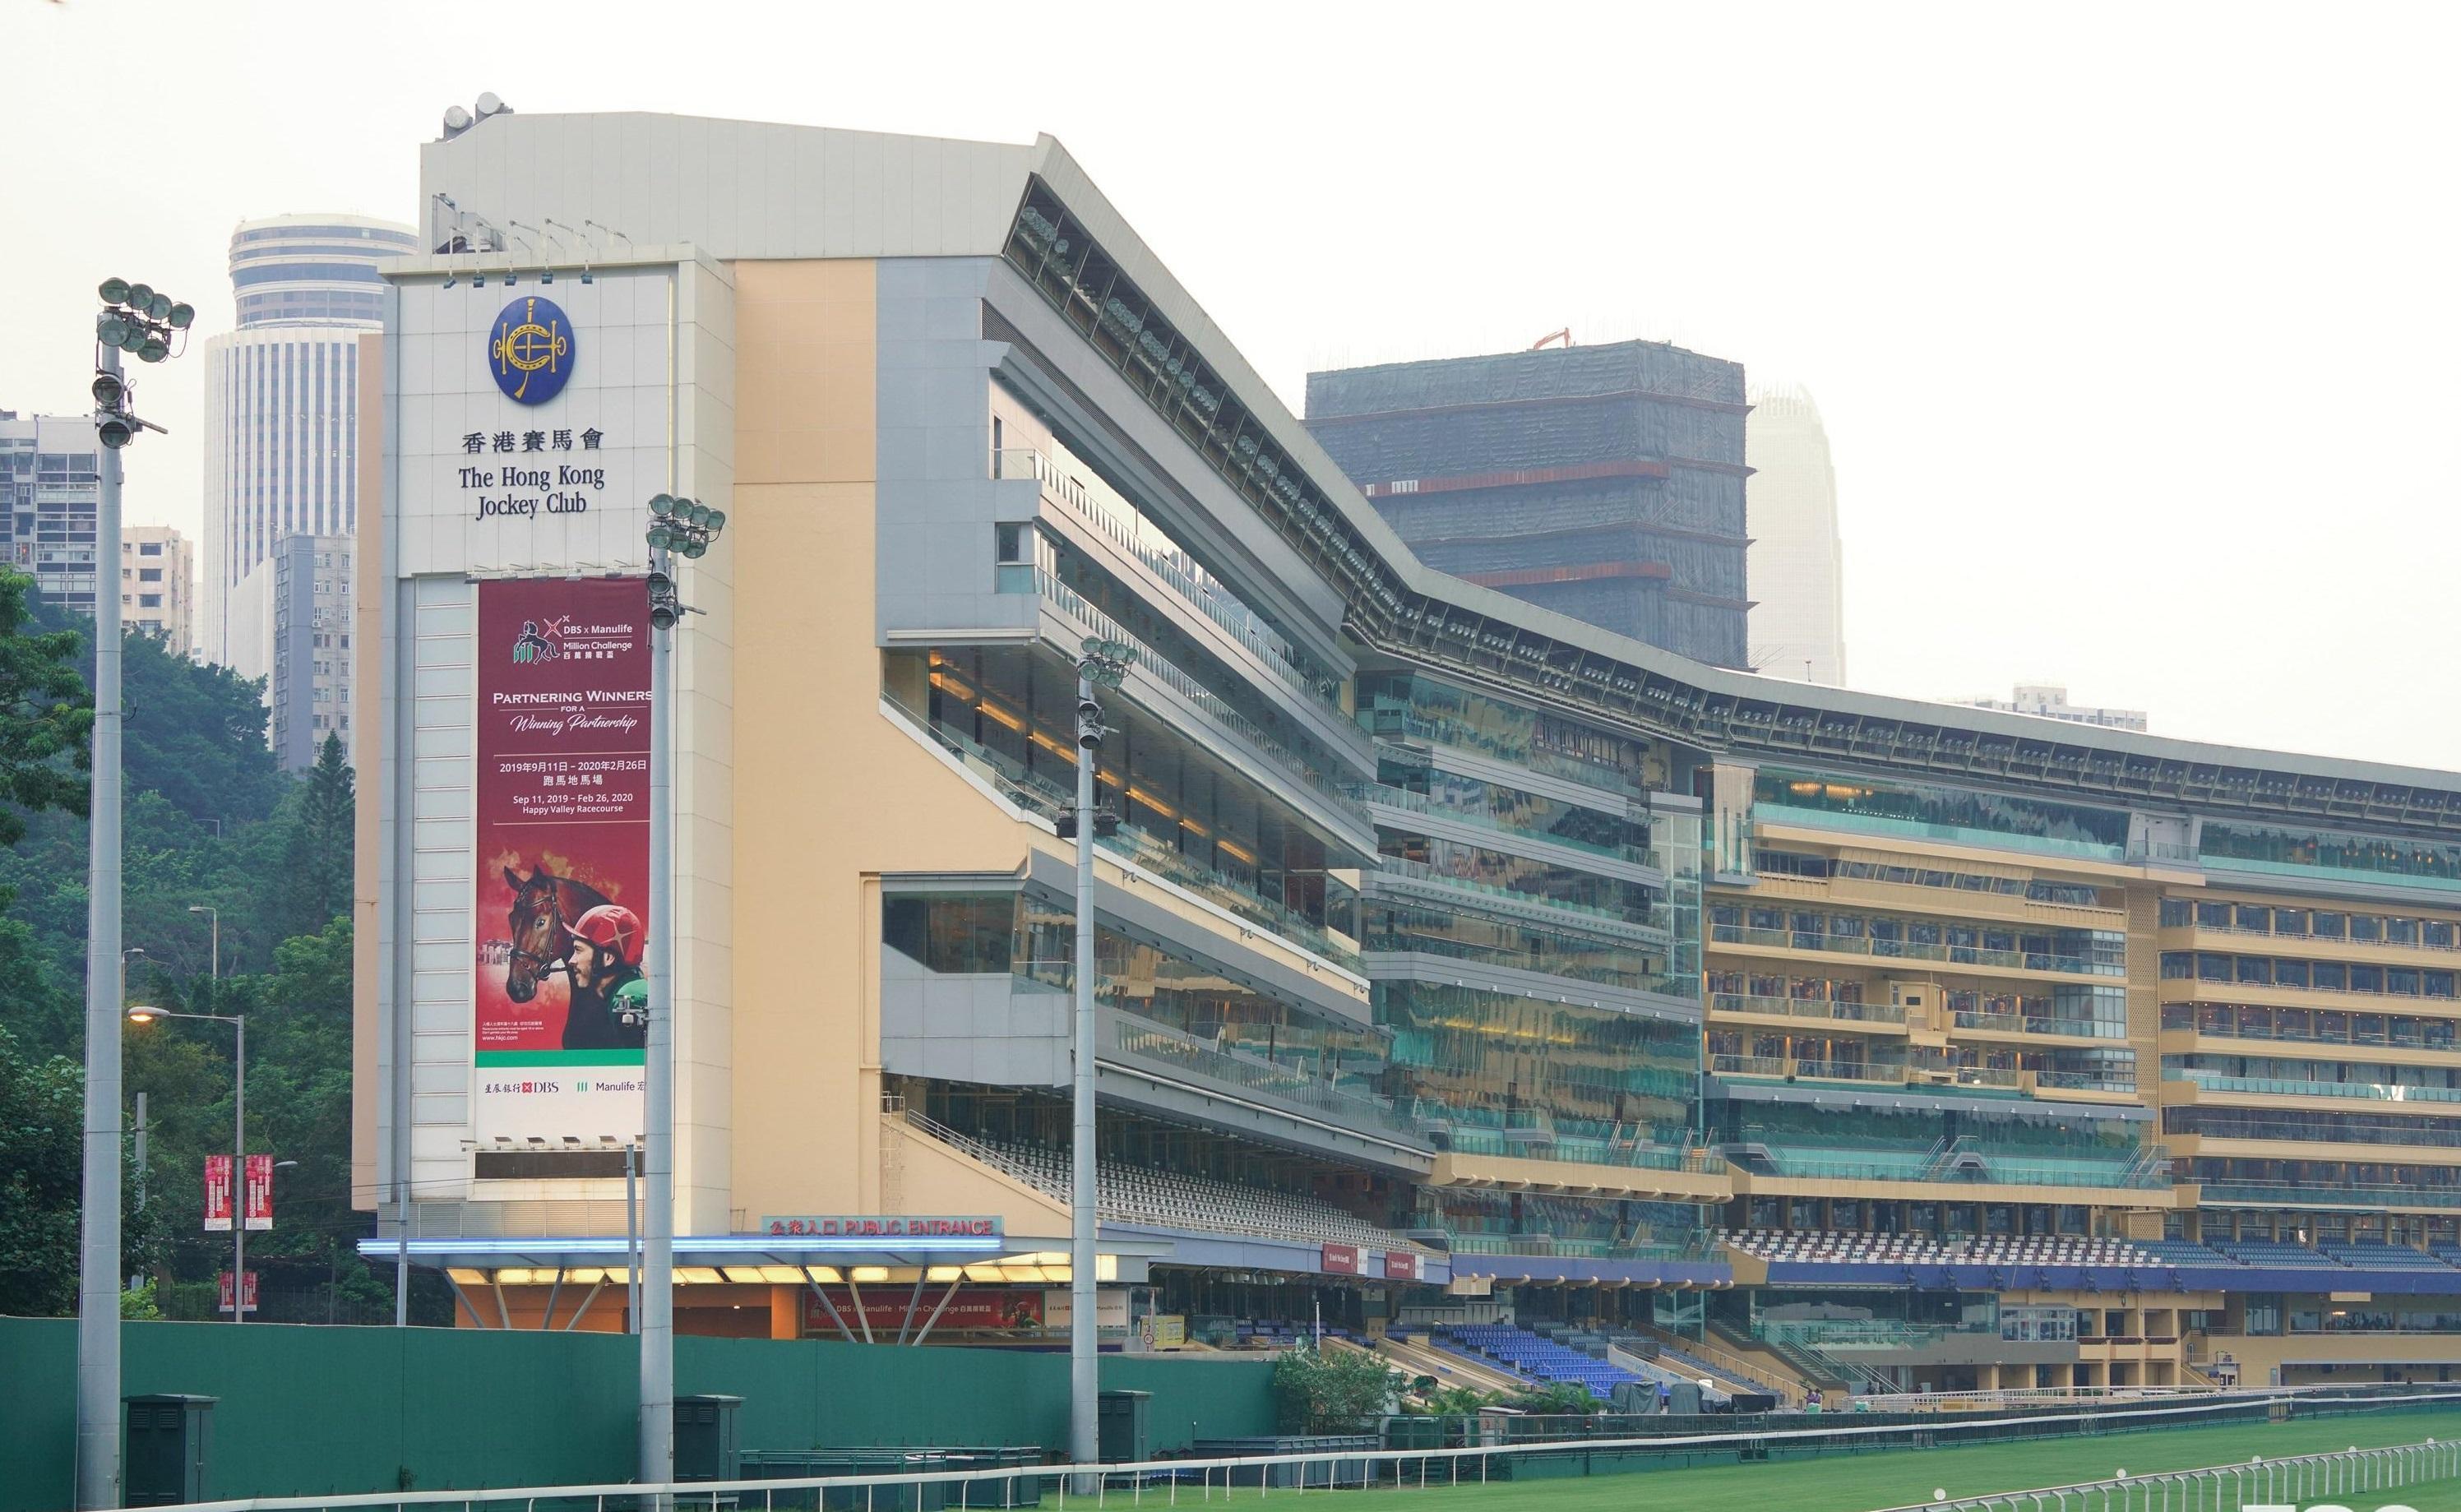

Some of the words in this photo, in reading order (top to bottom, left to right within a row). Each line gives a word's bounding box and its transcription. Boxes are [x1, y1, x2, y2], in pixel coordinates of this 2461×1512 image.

[462, 428, 604, 454] 香港賽馬會
[459, 466, 493, 488] The
[502, 466, 550, 492] Hong
[558, 465, 604, 490] Kong
[475, 493, 539, 520] Jockey
[547, 492, 586, 513] Club
[563, 626, 582, 634] DBS
[591, 624, 632, 633] Manulife
[591, 641, 632, 651] Challenge
[493, 692, 583, 705] PARTNERING
[586, 691, 652, 702] WINNERS
[510, 714, 564, 736] Winning
[567, 714, 638, 734] Partnership
[500, 761, 568, 773] 2019年9月11日
[578, 760, 646, 771] 2020年2月26日
[543, 774, 603, 786] 跑馬地馬場
[513, 796, 530, 805] Sep
[532, 795, 545, 804] 11,
[547, 795, 568, 803] 2019
[578, 794, 594, 802] Feb
[596, 794, 609, 803] 26,
[612, 793, 633, 802] 2020
[522, 806, 548, 816] Happy
[550, 806, 576, 815] Valley
[576, 805, 623, 813] Racecourse
[534, 1082, 559, 1093] DBS
[595, 1081, 635, 1092] Manulife
[638, 1081, 645, 1091] 宏
[844, 1220, 902, 1235] PUBLIC
[908, 1220, 994, 1236] ENTRANCE
[923, 1305, 959, 1315] Change
